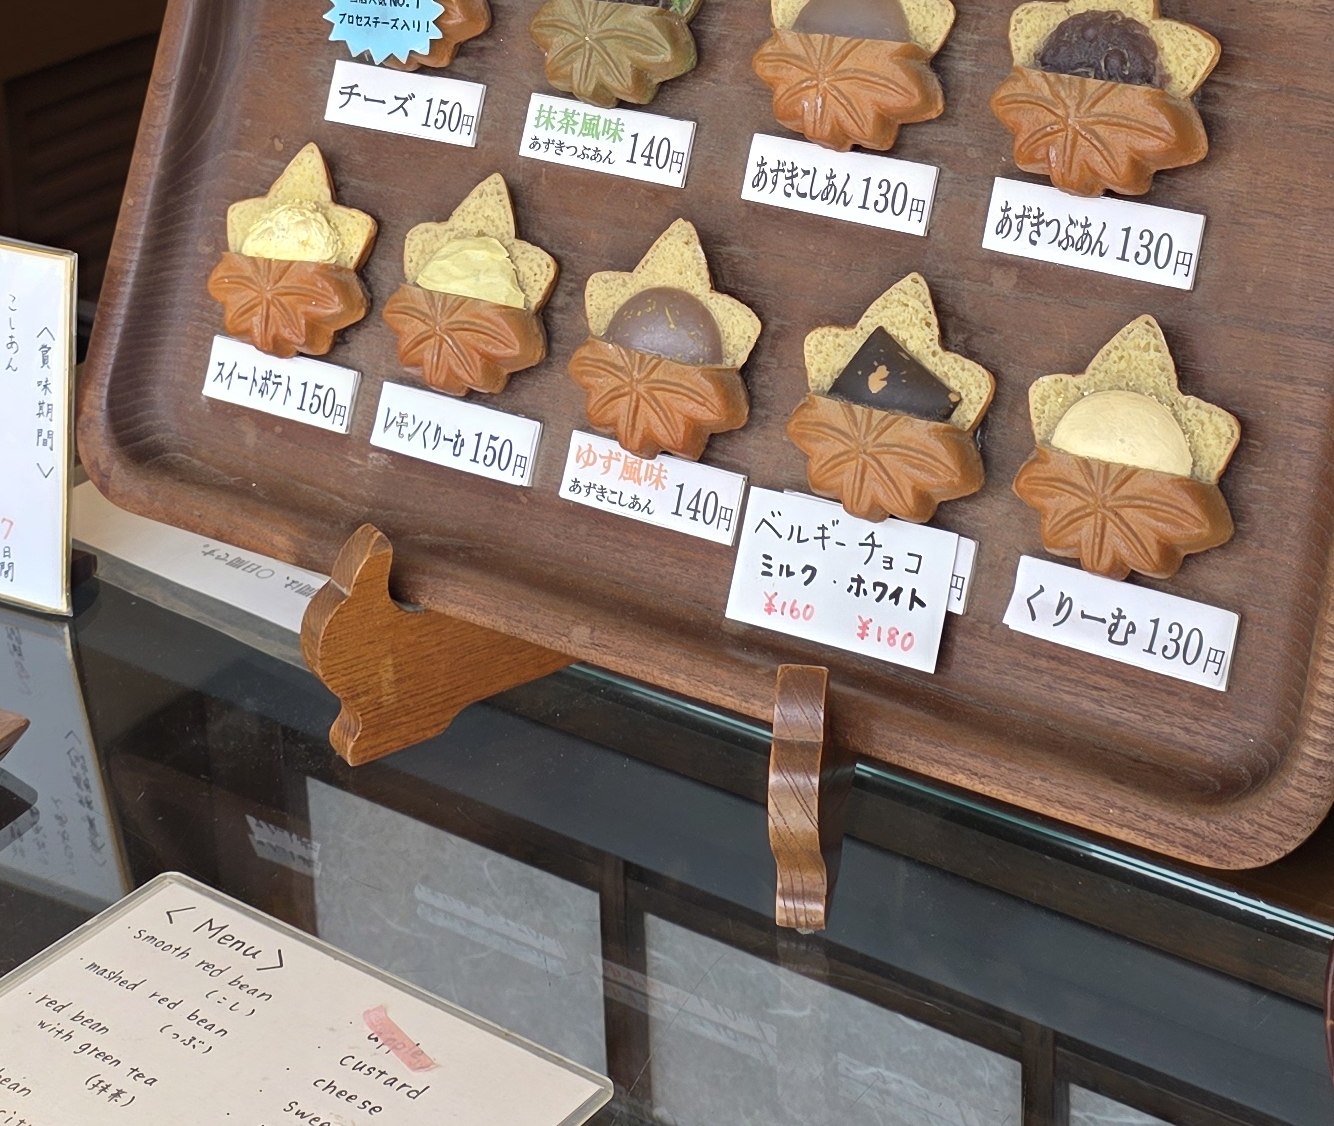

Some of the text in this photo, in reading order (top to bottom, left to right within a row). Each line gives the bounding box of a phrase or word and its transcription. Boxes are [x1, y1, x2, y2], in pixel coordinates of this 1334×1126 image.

[338, 83, 474, 136] チーズ 150円
[533, 104, 625, 143] 抹茶風味
[528, 132, 684, 174] あずきつぶあん 140円
[751, 156, 925, 224] あずきこしあん 130円
[994, 200, 1193, 277] あずきつぶあん 130円
[4, 293, 19, 372] こしあん
[212, 360, 347, 427] スイートポテト 150円
[382, 406, 527, 479] レモンくりーむ 150円
[575, 447, 670, 491] ゆず風味
[568, 478, 733, 532] あずきこしあん 140円
[1024, 584, 1225, 677] くりーむ 130円
[134, 928, 272, 1001] smooth red bean
[35, 994, 110, 1035] red bean
[85, 961, 228, 1037] mashed red bean
[37, 1019, 158, 1087] with green tea
[313, 1078, 383, 1115] cheese
